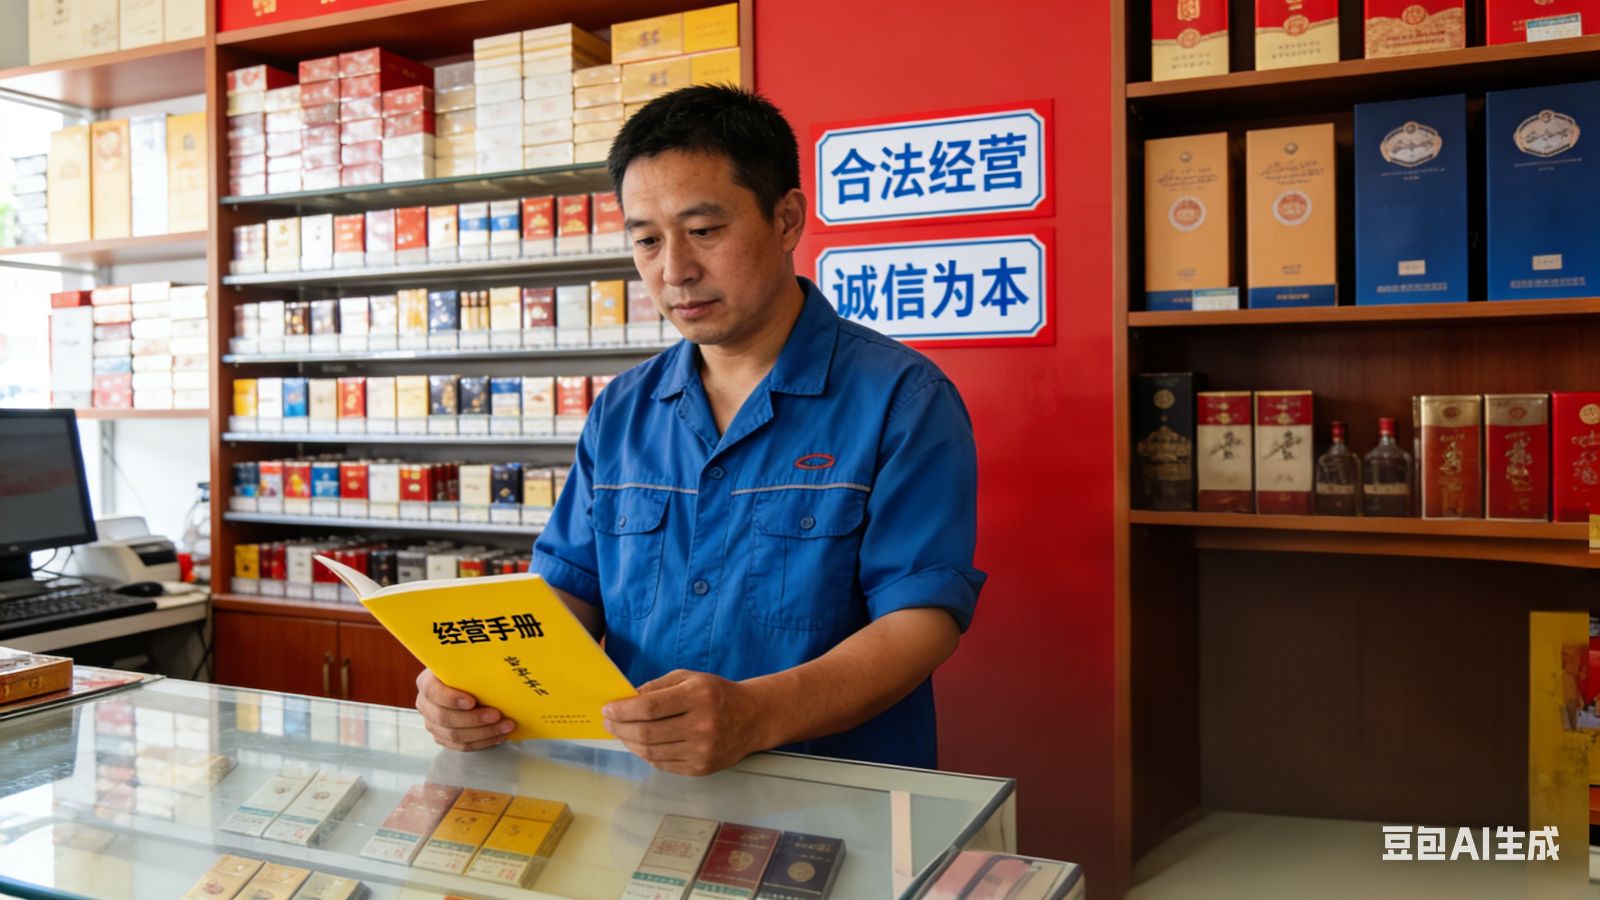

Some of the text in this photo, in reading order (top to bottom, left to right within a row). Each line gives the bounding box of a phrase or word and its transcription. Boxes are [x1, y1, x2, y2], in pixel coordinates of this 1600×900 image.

[831, 132, 1027, 205] 合法经营
[832, 257, 1029, 321] 诚信为本
[432, 613, 545, 646] 经营手册
